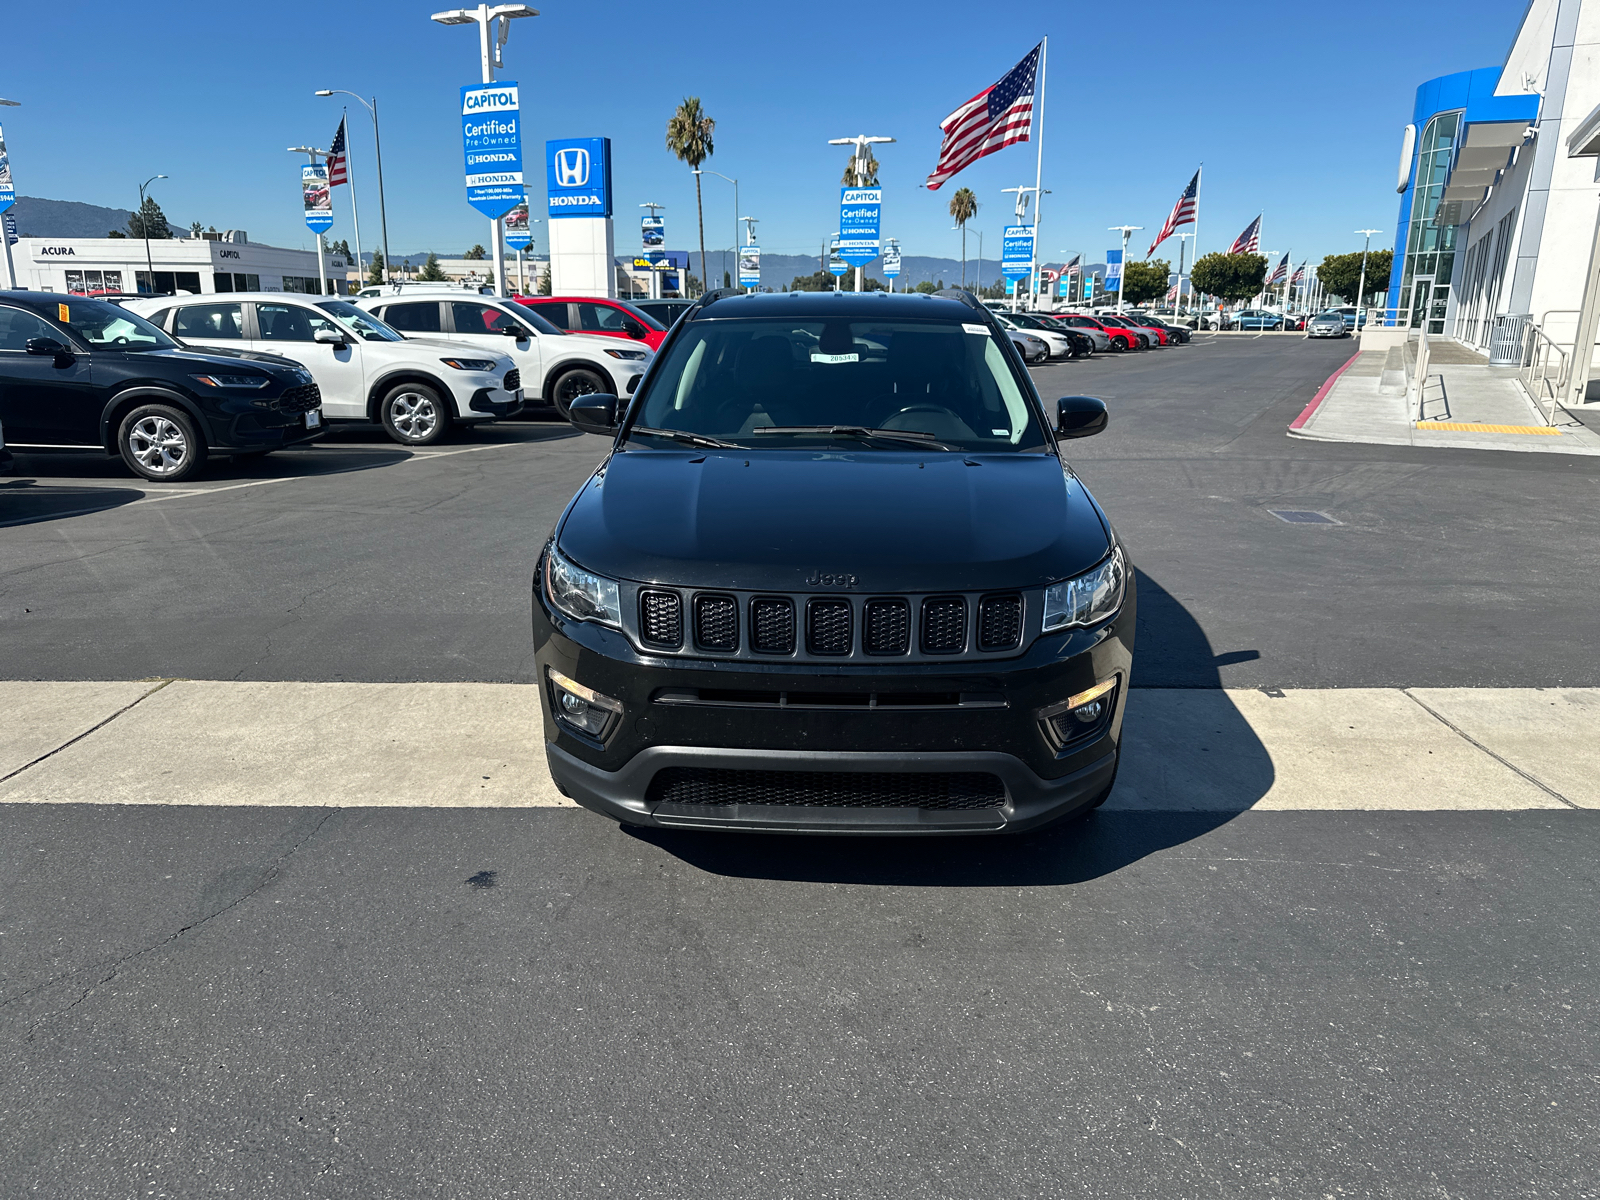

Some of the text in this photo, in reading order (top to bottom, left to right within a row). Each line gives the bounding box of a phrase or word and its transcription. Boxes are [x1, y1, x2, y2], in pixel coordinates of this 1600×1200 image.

[466, 92, 517, 109] CAPITOL
[465, 119, 516, 137] Certified
[466, 135, 516, 147] Pre-Owned
[475, 153, 517, 163] HONDA
[303, 169, 328, 177] CAPITOL
[477, 174, 517, 183] HONDA
[549, 195, 602, 207] HONDA
[845, 193, 879, 201] CAPITOL
[842, 208, 878, 218] Certified
[41, 247, 76, 256] ACURA
[220, 250, 240, 259] CAPITOL
[805, 569, 860, 589] Jeep
